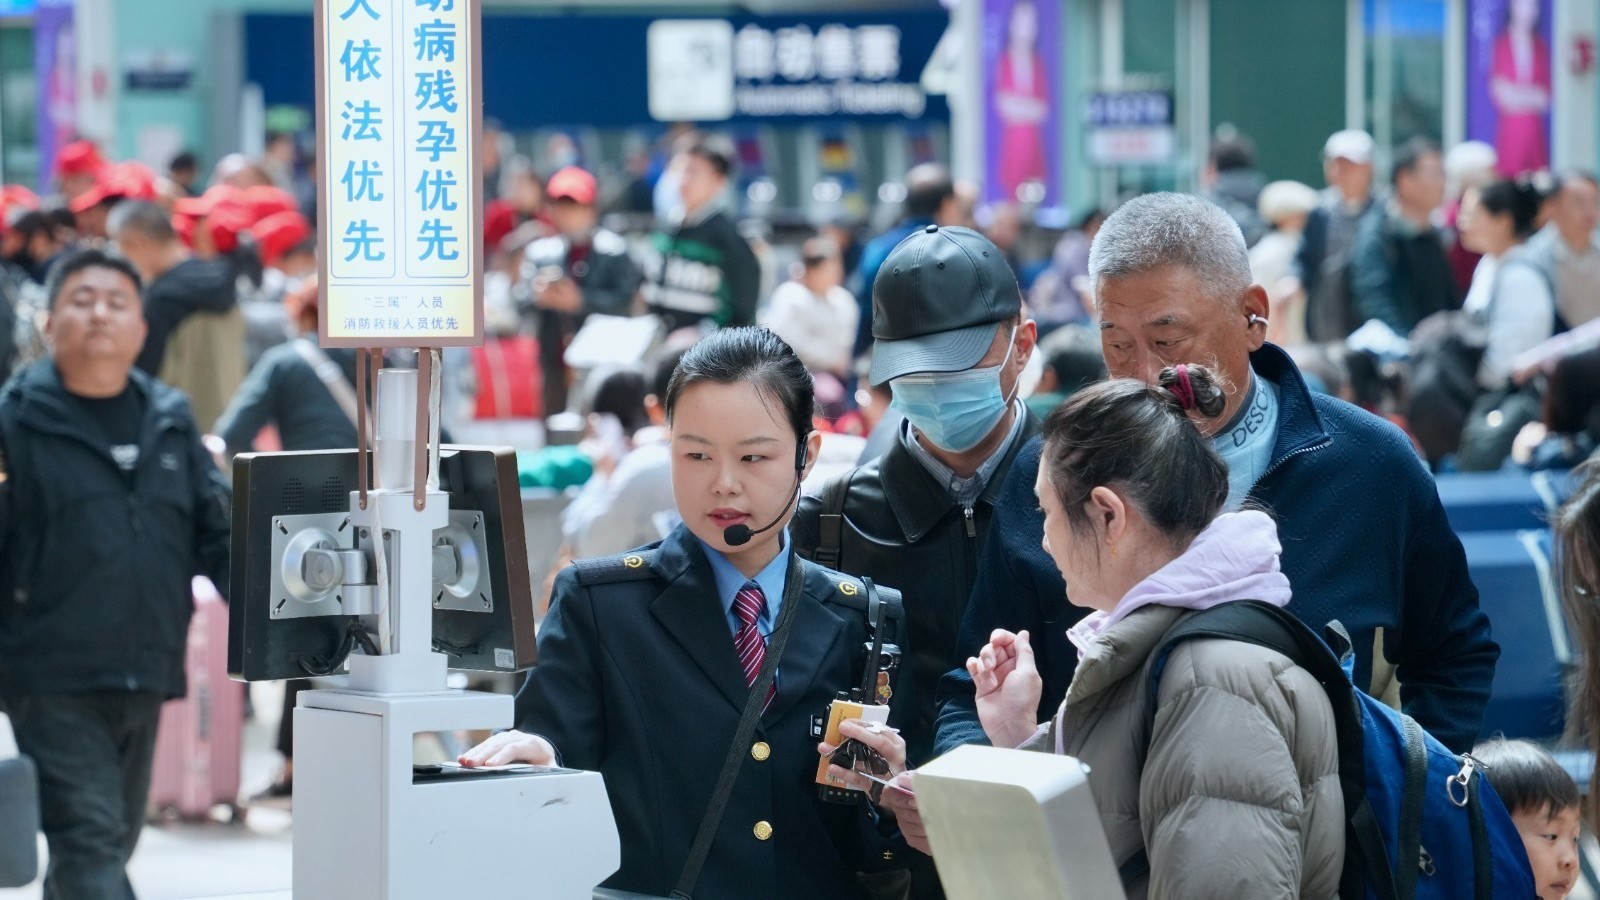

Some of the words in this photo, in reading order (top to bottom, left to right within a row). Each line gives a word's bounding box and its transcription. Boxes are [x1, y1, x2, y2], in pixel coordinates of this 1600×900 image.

[412, 0, 459, 262] 病残孕优先
[343, 316, 459, 330] 消防救援人员优先
